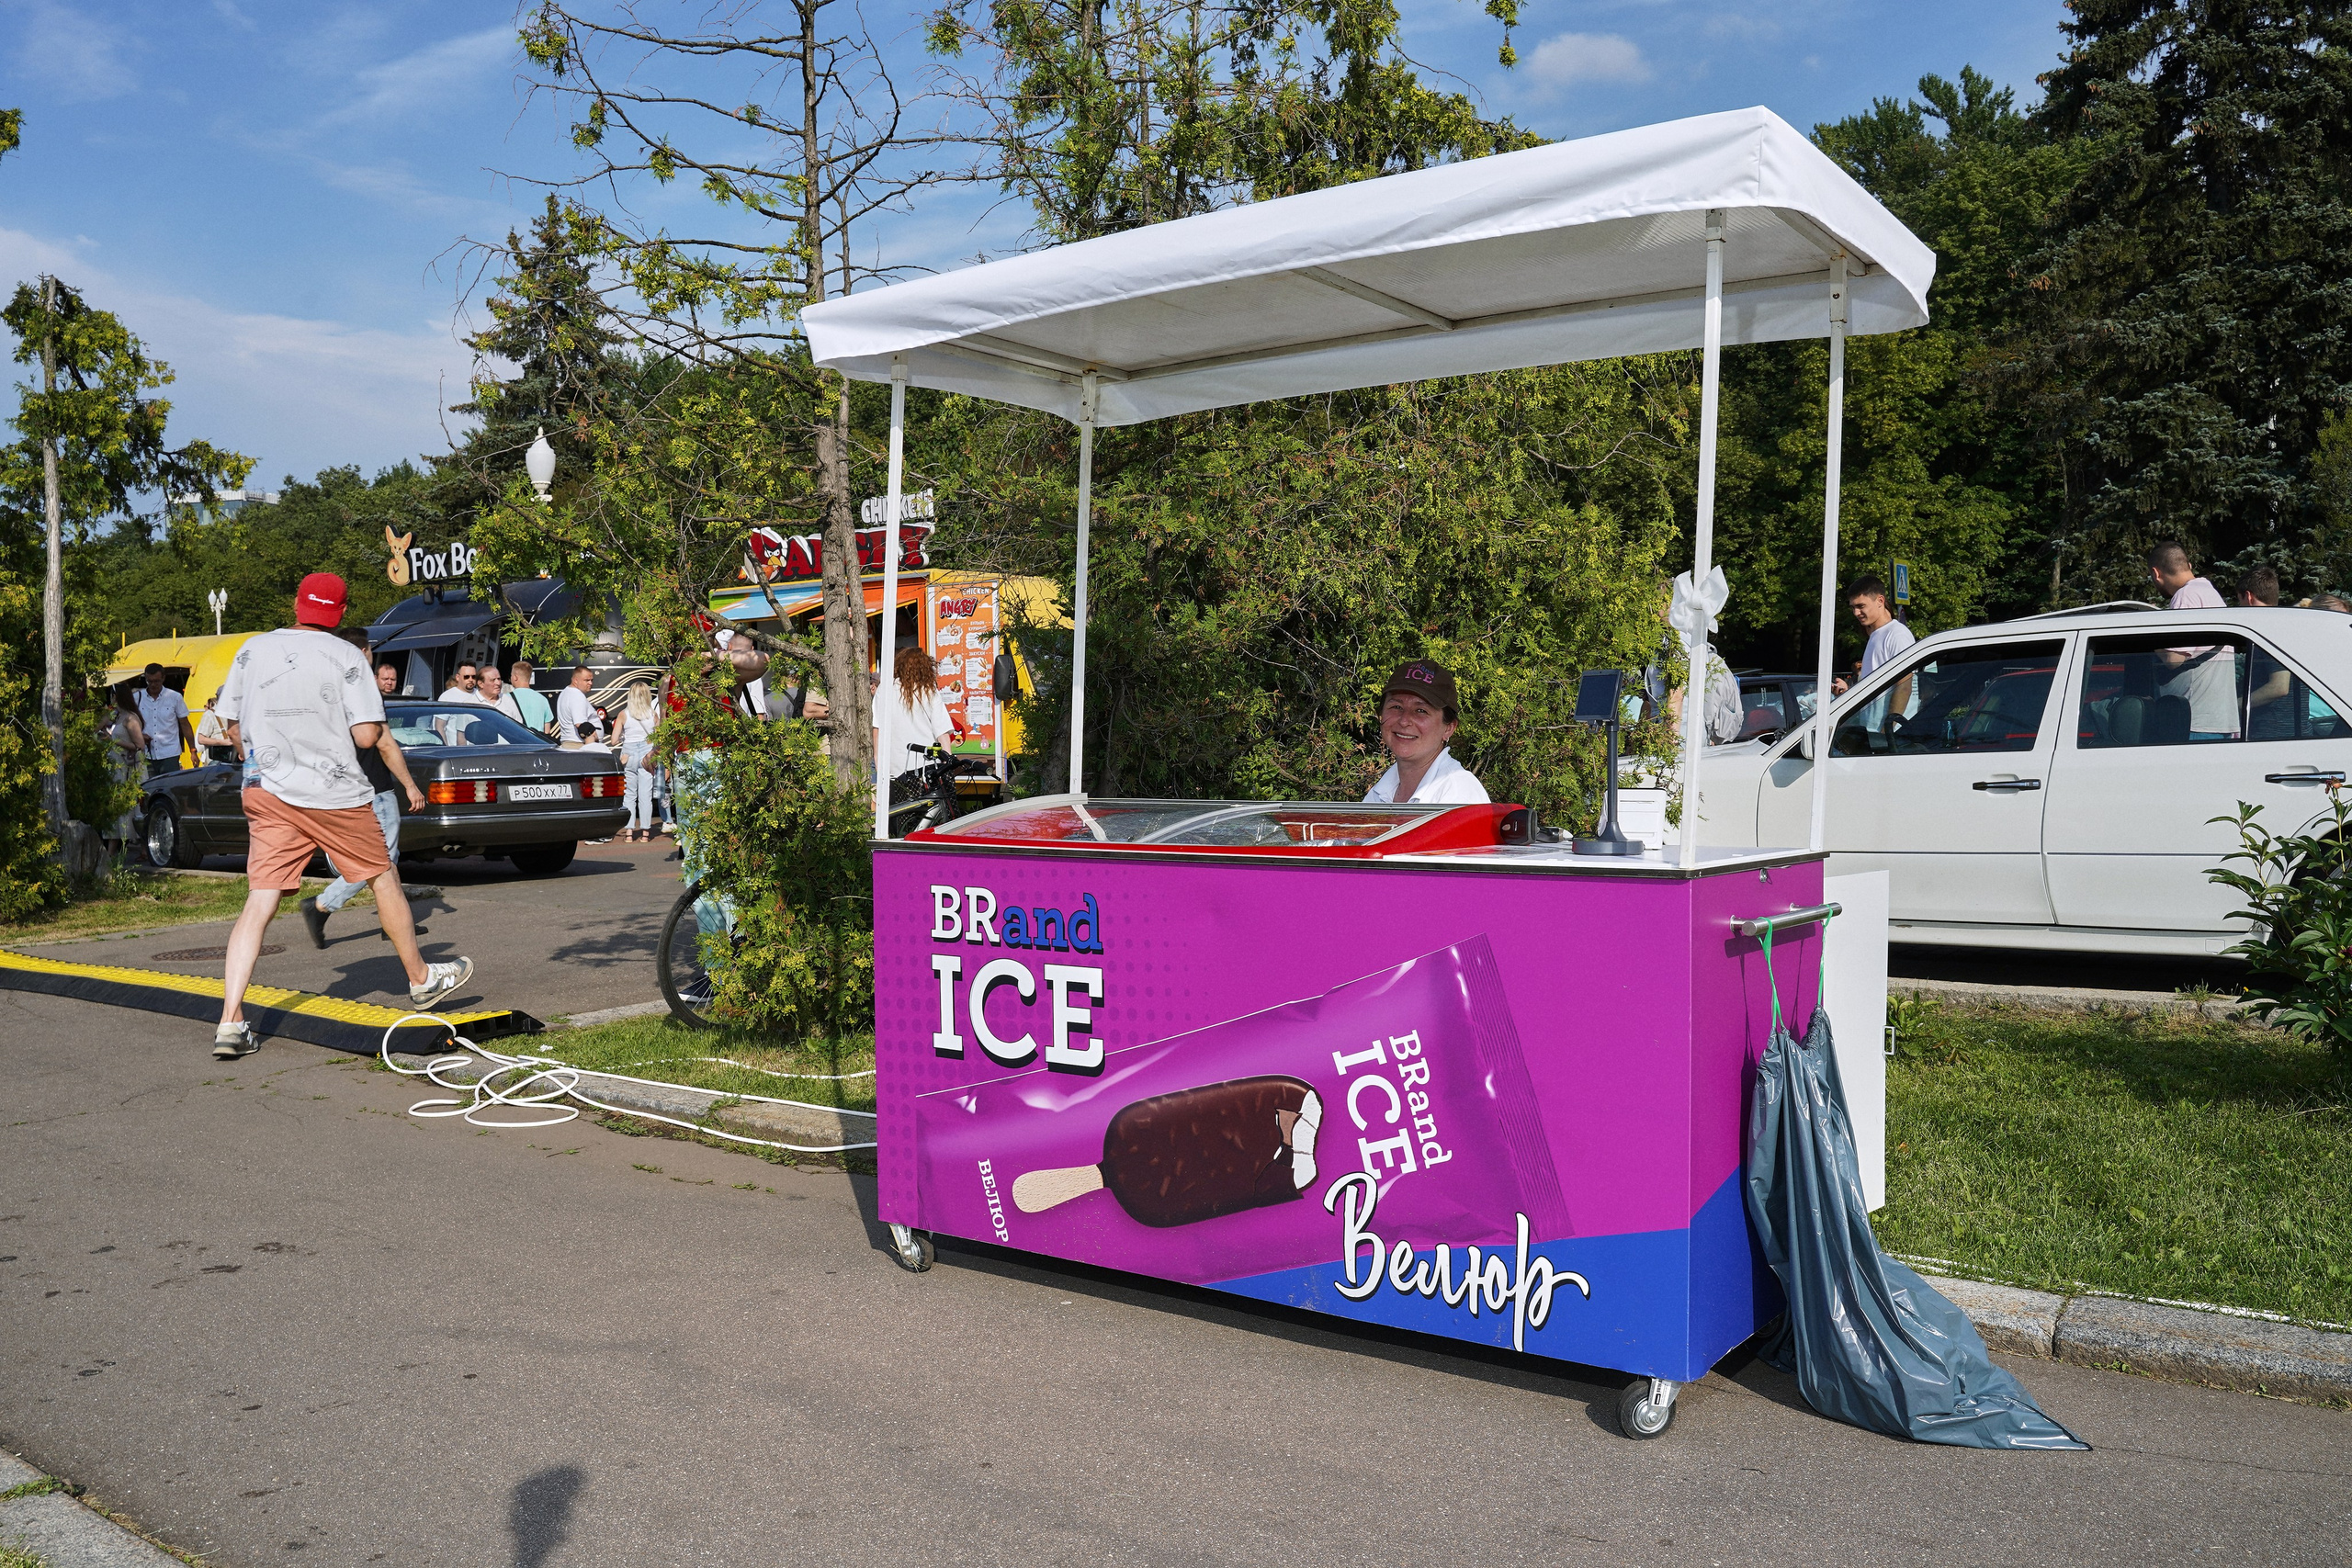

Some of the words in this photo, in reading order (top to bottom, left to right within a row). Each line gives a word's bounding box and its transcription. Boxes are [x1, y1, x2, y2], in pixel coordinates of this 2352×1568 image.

[861, 488, 934, 524] CHIKEN
[939, 597, 978, 617] ANGRY
[962, 587, 989, 595] CHICKEN
[1405, 668, 1434, 684] ICE
[930, 884, 1103, 953] BRand
[931, 953, 1104, 1074] ICE
[1331, 1039, 1418, 1179] ICE
[1388, 1029, 1453, 1168] BRand
[978, 1158, 1009, 1243] ВЕЛЮР
[1322, 1171, 1590, 1352] Велюр
